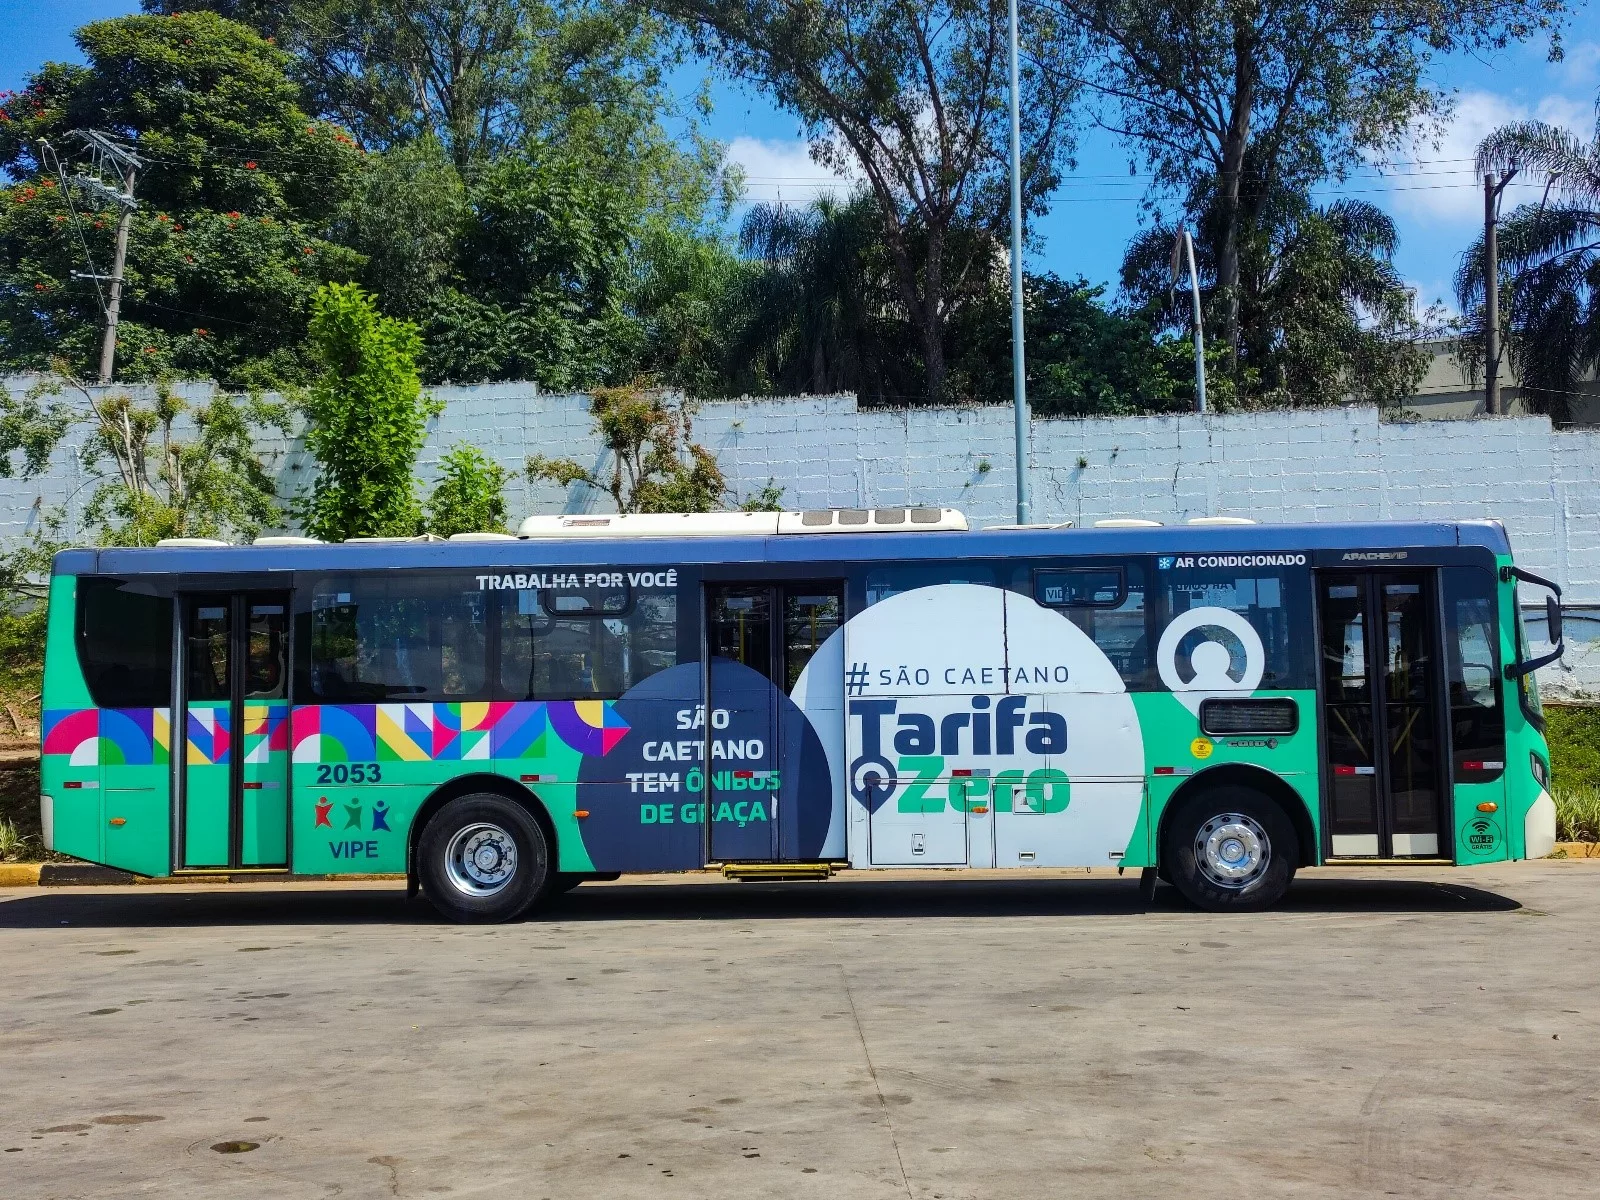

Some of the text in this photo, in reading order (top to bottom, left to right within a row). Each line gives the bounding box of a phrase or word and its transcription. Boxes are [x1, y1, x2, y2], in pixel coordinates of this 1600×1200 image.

[1176, 555, 1306, 568] AR CONDICIONADO
[476, 568, 678, 591] TRABALHA POR VOCÊ
[945, 666, 1069, 685] CAETANO
[676, 705, 730, 730] SÃO
[849, 696, 1068, 755] Tarifa
[642, 739, 764, 761] CAETANO
[317, 764, 381, 784] 2053
[626, 773, 680, 792] TEM
[898, 756, 1071, 813] Zero
[640, 804, 674, 824] DE
[328, 841, 379, 858] VIPE
